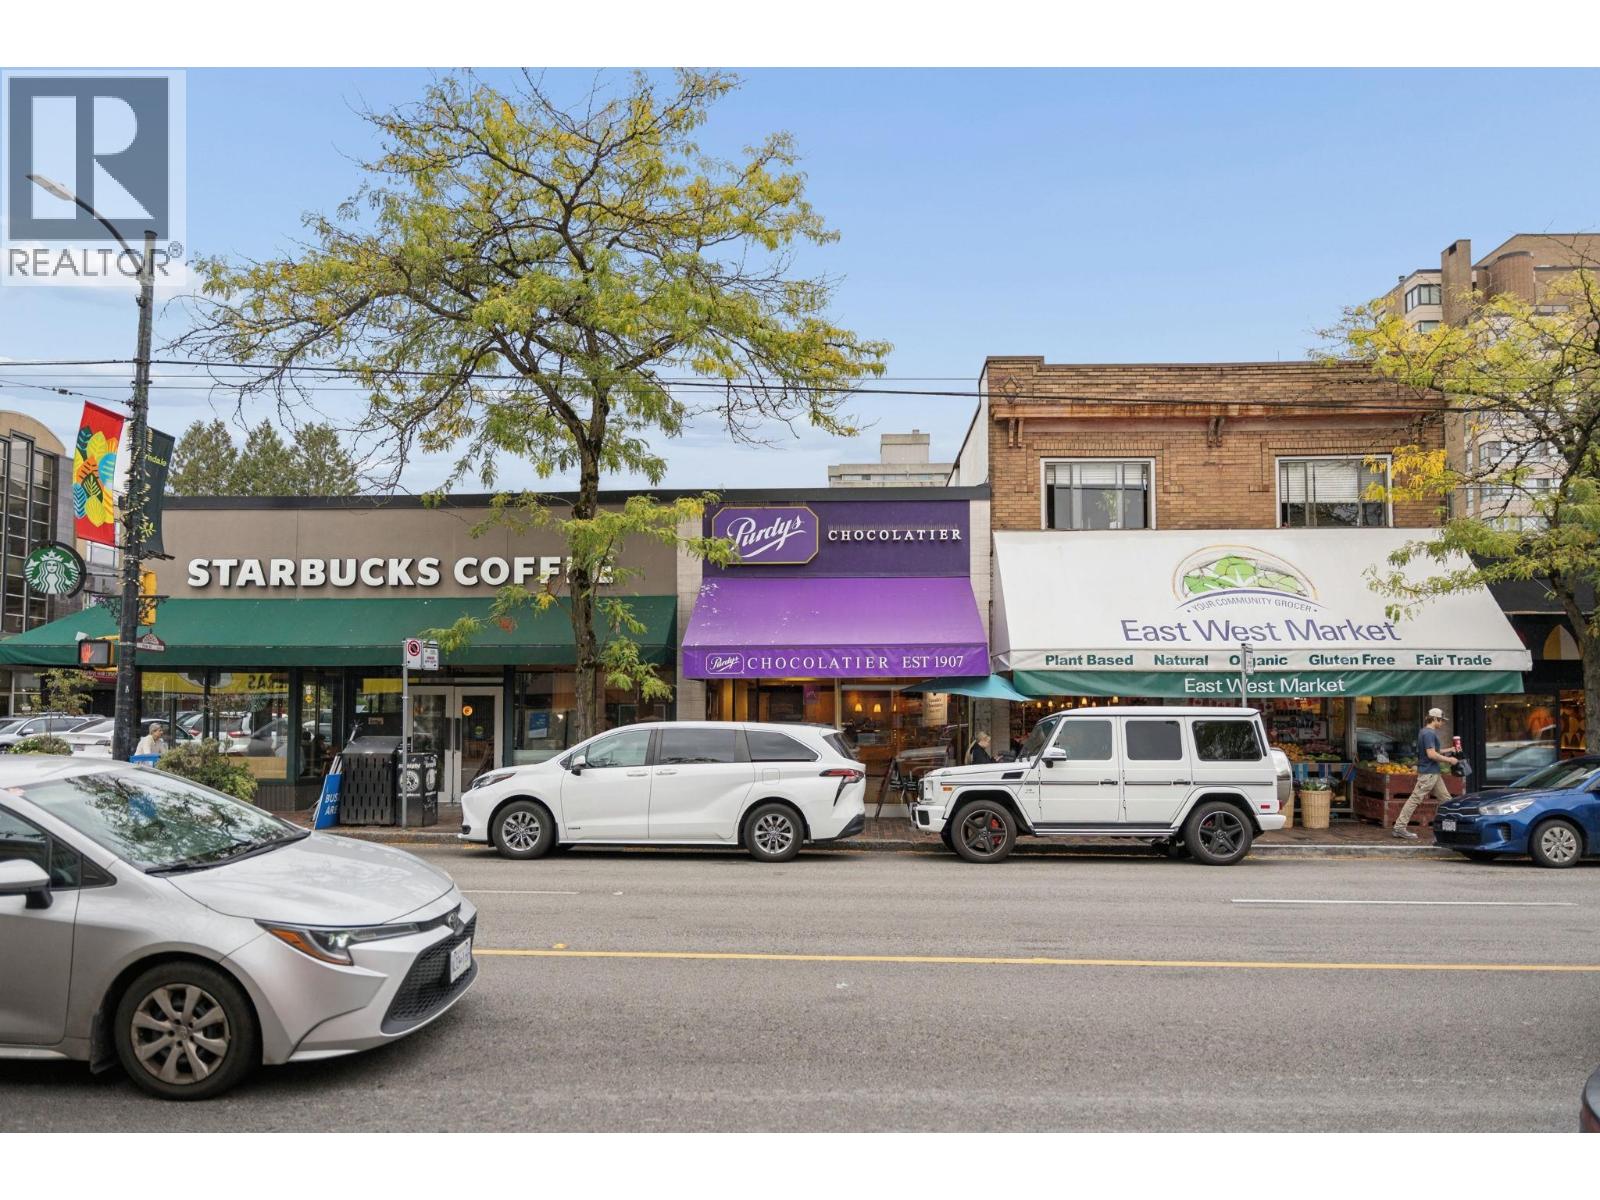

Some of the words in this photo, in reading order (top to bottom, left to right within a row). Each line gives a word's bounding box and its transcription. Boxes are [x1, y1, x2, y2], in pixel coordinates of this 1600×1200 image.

[827, 528, 963, 542] CHOCOLATIER
[187, 557, 441, 587] STARBUCKS
[1192, 601, 1216, 611] YOUR
[1215, 597, 1272, 607] COMMUNITY
[1274, 599, 1312, 613] GROCER
[1120, 619, 1191, 642] East
[1192, 619, 1281, 642] West
[1285, 618, 1402, 642] Market
[747, 657, 889, 670] CHOCOLATIER
[902, 656, 932, 669] EST
[935, 655, 964, 669] 1907
[1045, 654, 1084, 666] Plant
[1086, 654, 1134, 666] Based
[1154, 654, 1209, 666] Natural
[1308, 654, 1359, 666] Gluten
[1362, 654, 1396, 666] Free
[1416, 654, 1445, 666] Fair
[1446, 654, 1492, 666] Trade
[1184, 678, 1223, 693] East
[1226, 678, 1276, 693] West
[1280, 677, 1346, 693] Market
